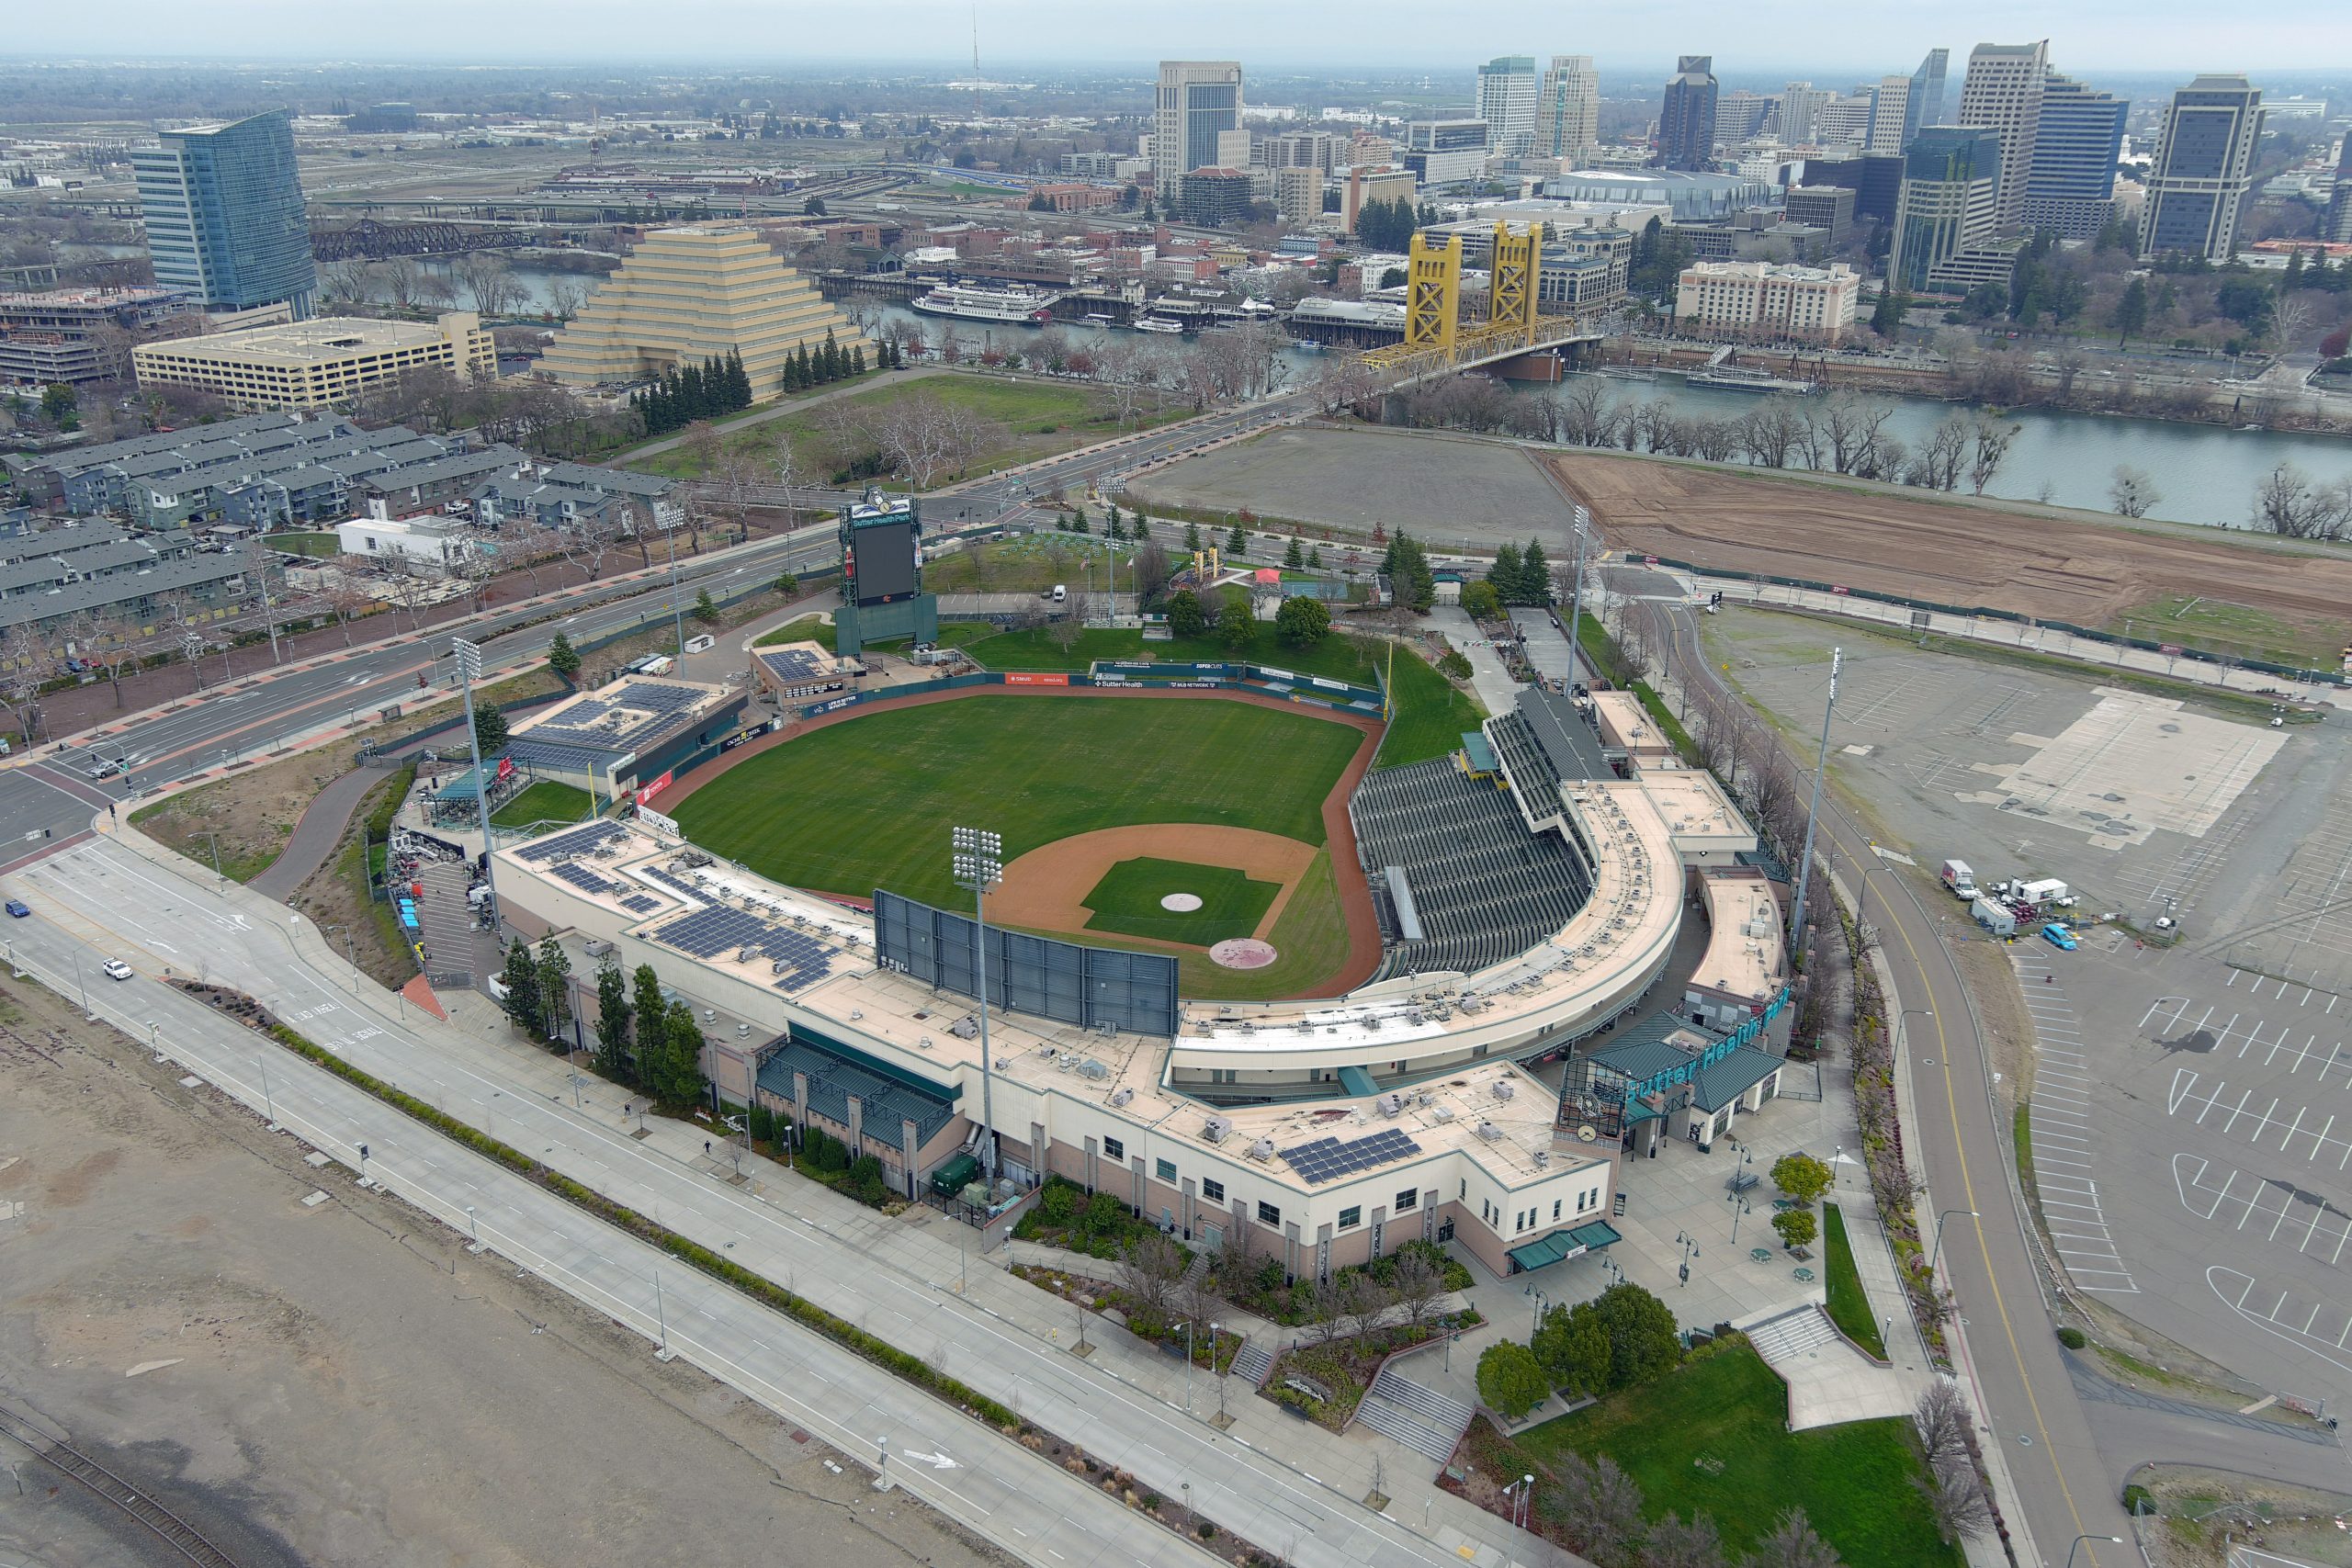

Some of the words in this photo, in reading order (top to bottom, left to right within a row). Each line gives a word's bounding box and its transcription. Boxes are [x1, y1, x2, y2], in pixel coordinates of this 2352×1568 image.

[874, 516, 894, 524] Health
[1626, 1060, 1698, 1103] Sutter
[1702, 1018, 1758, 1070] Health
[1764, 987, 1789, 1028] Park
